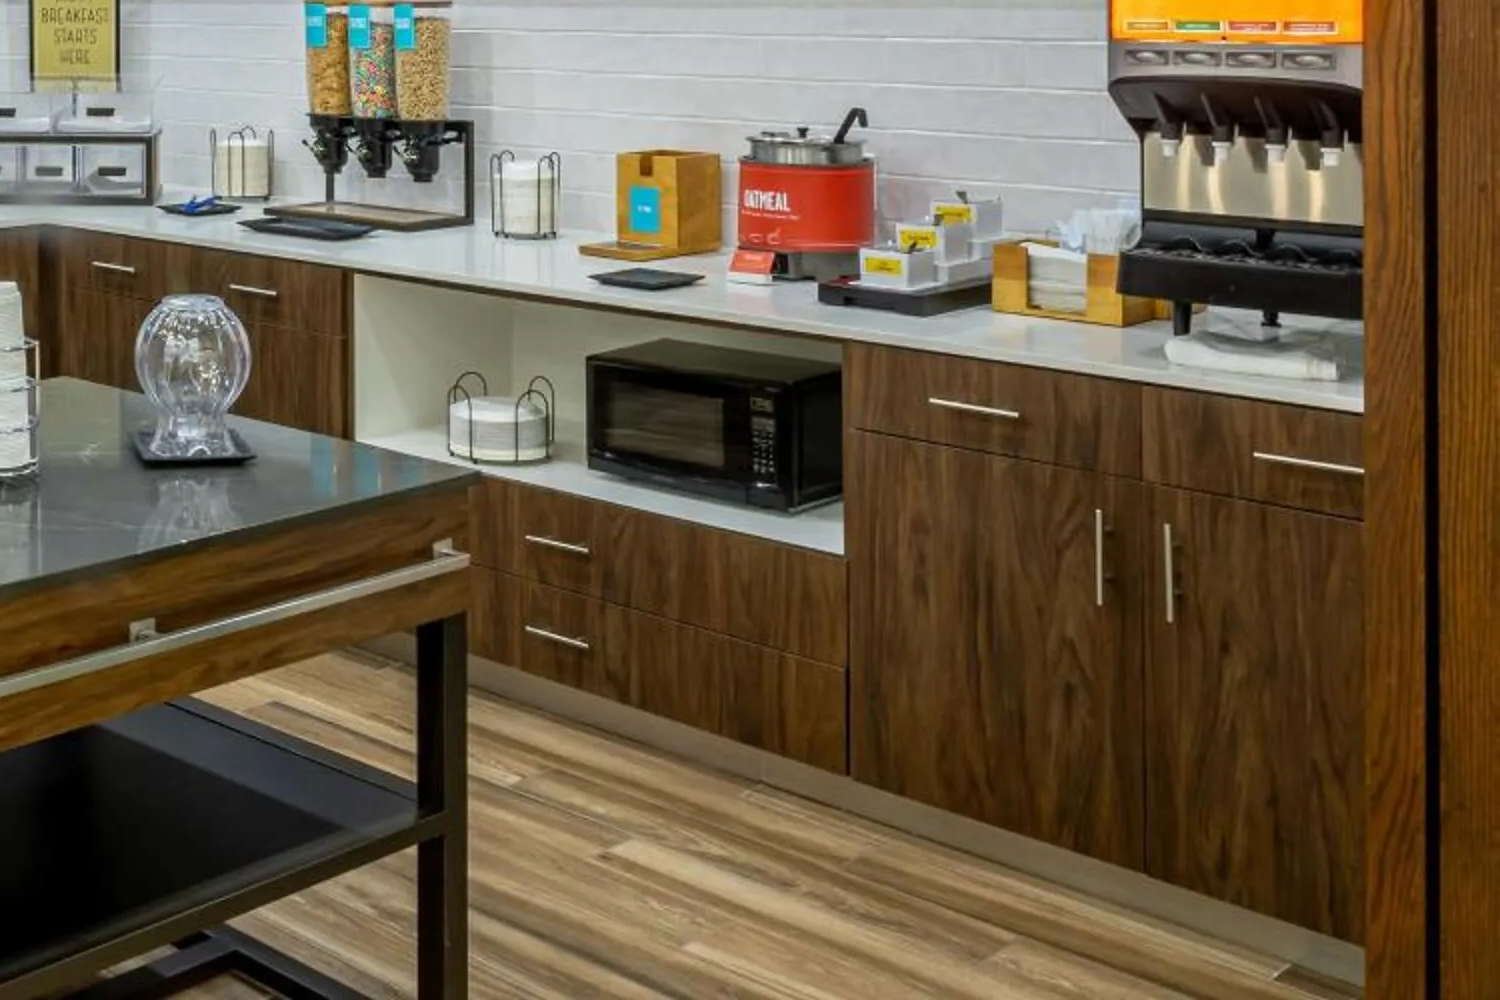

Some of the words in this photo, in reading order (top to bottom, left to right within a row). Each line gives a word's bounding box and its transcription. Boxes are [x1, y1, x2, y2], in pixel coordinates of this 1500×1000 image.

[41, 7, 108, 24] BREAKFAST
[53, 28, 97, 45] STARTS
[59, 48, 91, 65] HERE
[743, 189, 791, 211] OATMEAL
